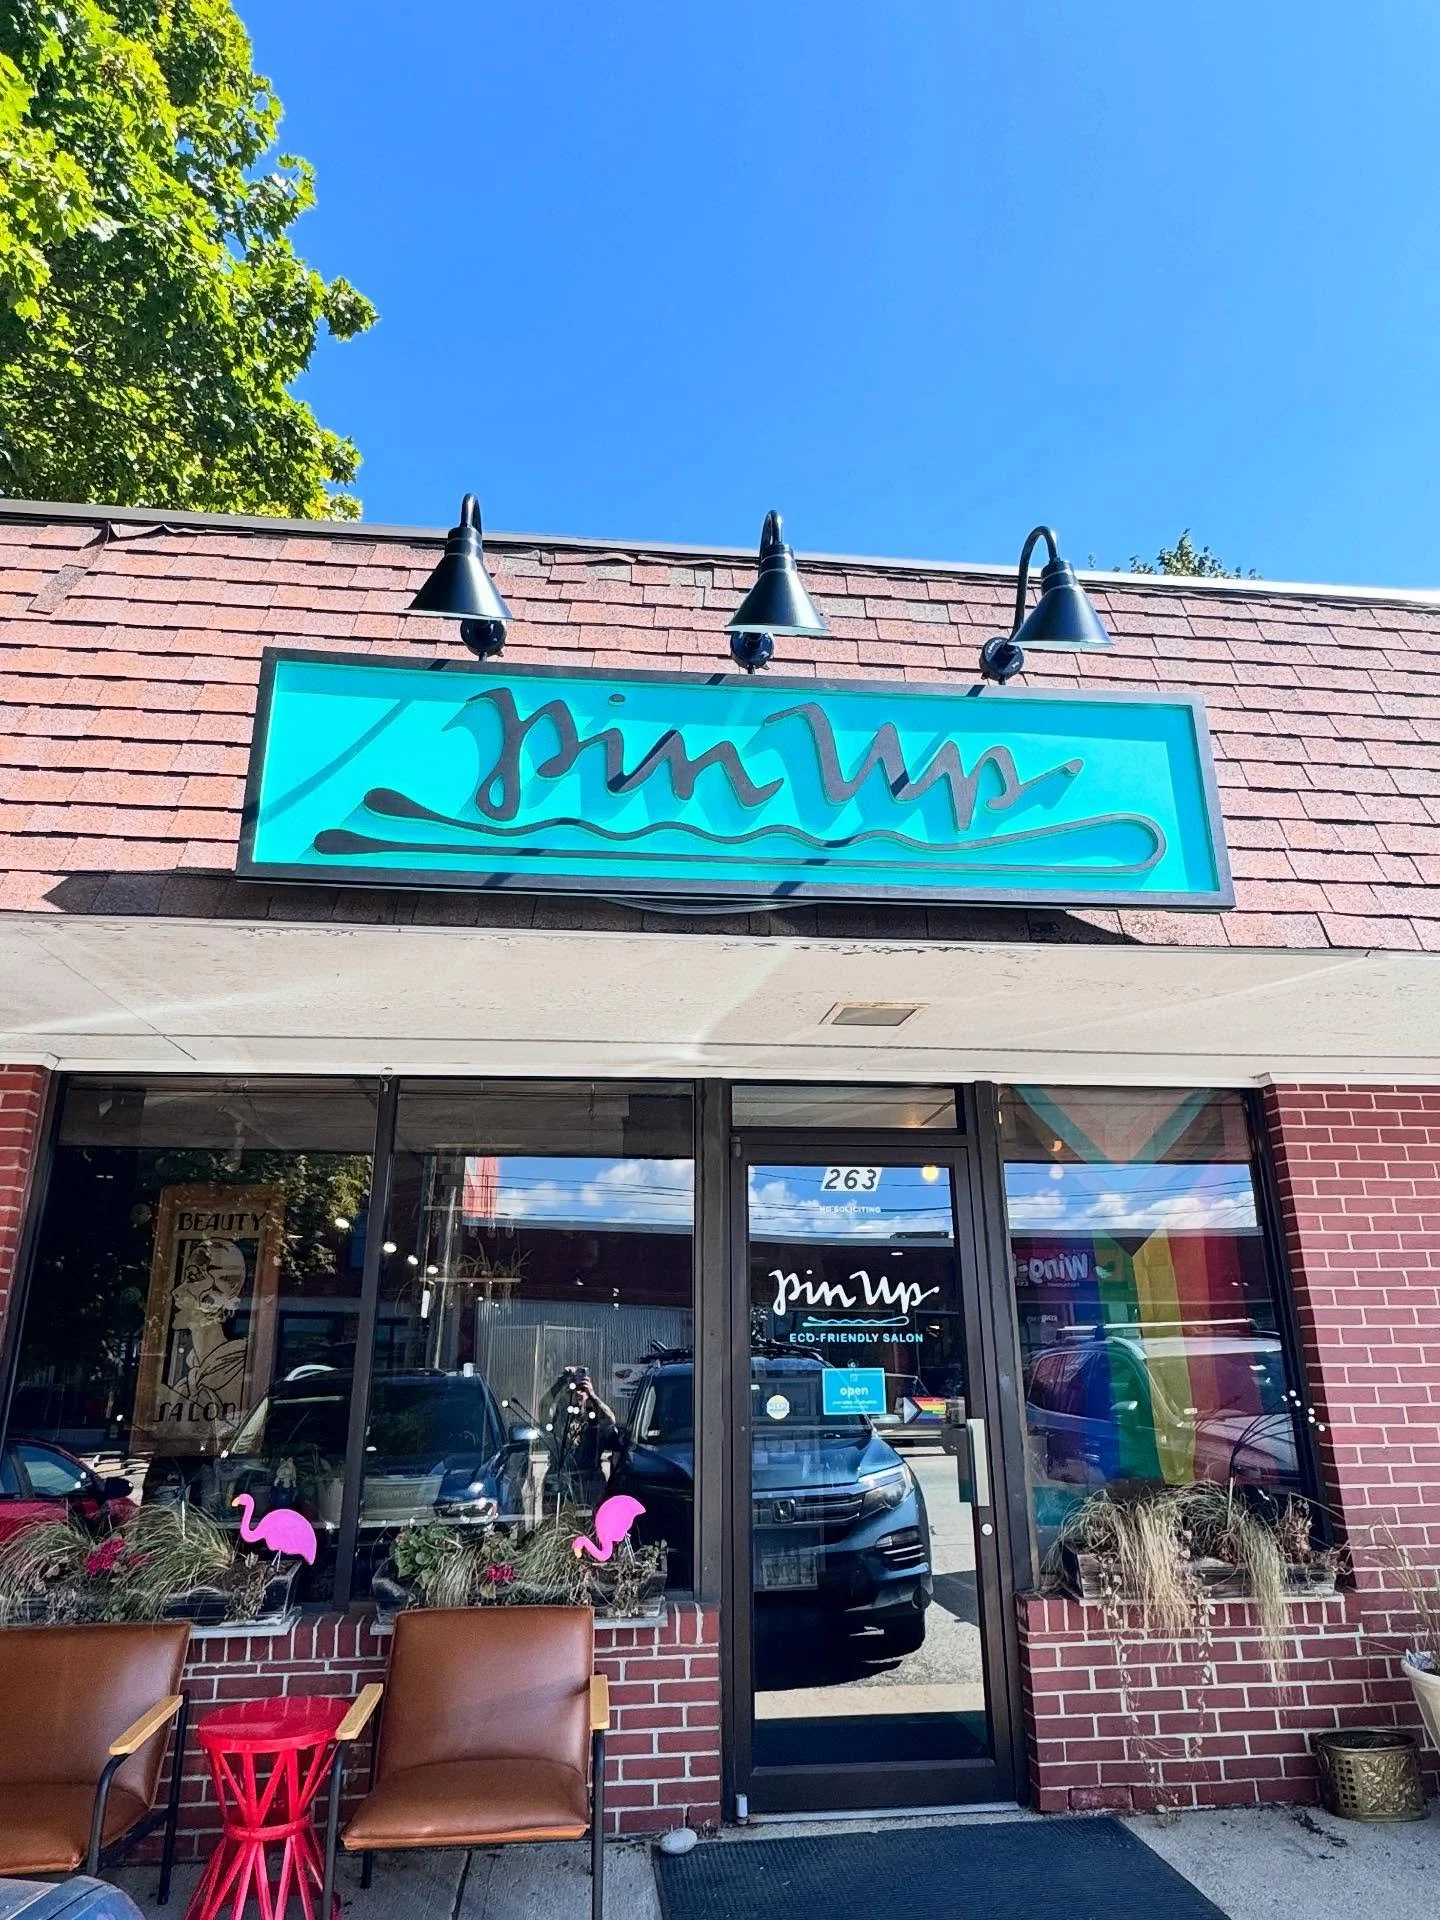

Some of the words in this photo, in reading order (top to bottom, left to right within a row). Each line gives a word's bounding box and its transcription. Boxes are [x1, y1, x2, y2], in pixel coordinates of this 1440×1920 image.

[764, 701, 1086, 832] Up
[824, 1168, 877, 1190] 263
[820, 1205, 831, 1214] NO
[833, 1205, 881, 1214] SOLICITING
[178, 1212, 267, 1232] BEAUTY
[849, 1270, 940, 1314] Up
[789, 1332, 880, 1344] ECO-FRIENDLY
[882, 1332, 924, 1343] SALON
[839, 1386, 869, 1399] open
[153, 1401, 238, 1423] SALON
